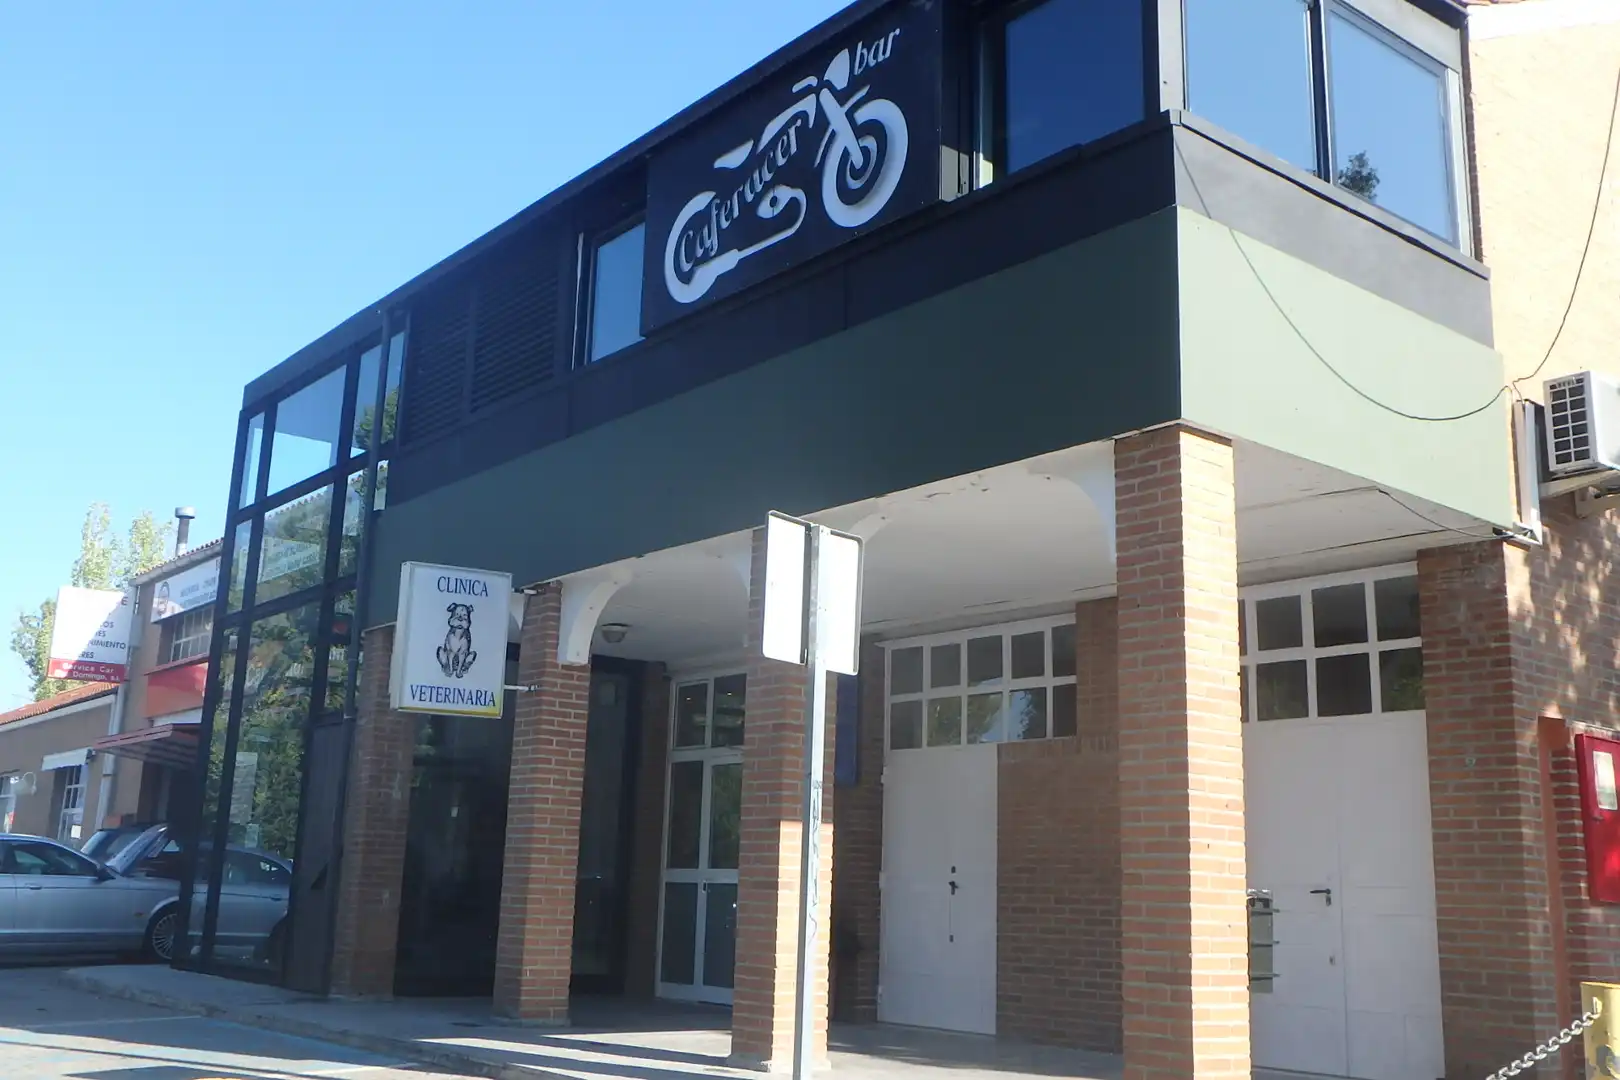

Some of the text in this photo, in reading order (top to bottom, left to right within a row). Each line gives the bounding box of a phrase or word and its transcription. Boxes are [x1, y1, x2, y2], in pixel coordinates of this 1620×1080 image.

[854, 28, 900, 75] bar
[437, 576, 489, 597] CLINICA
[99, 665, 115, 673] Car
[410, 684, 496, 707] VETERINARIA
